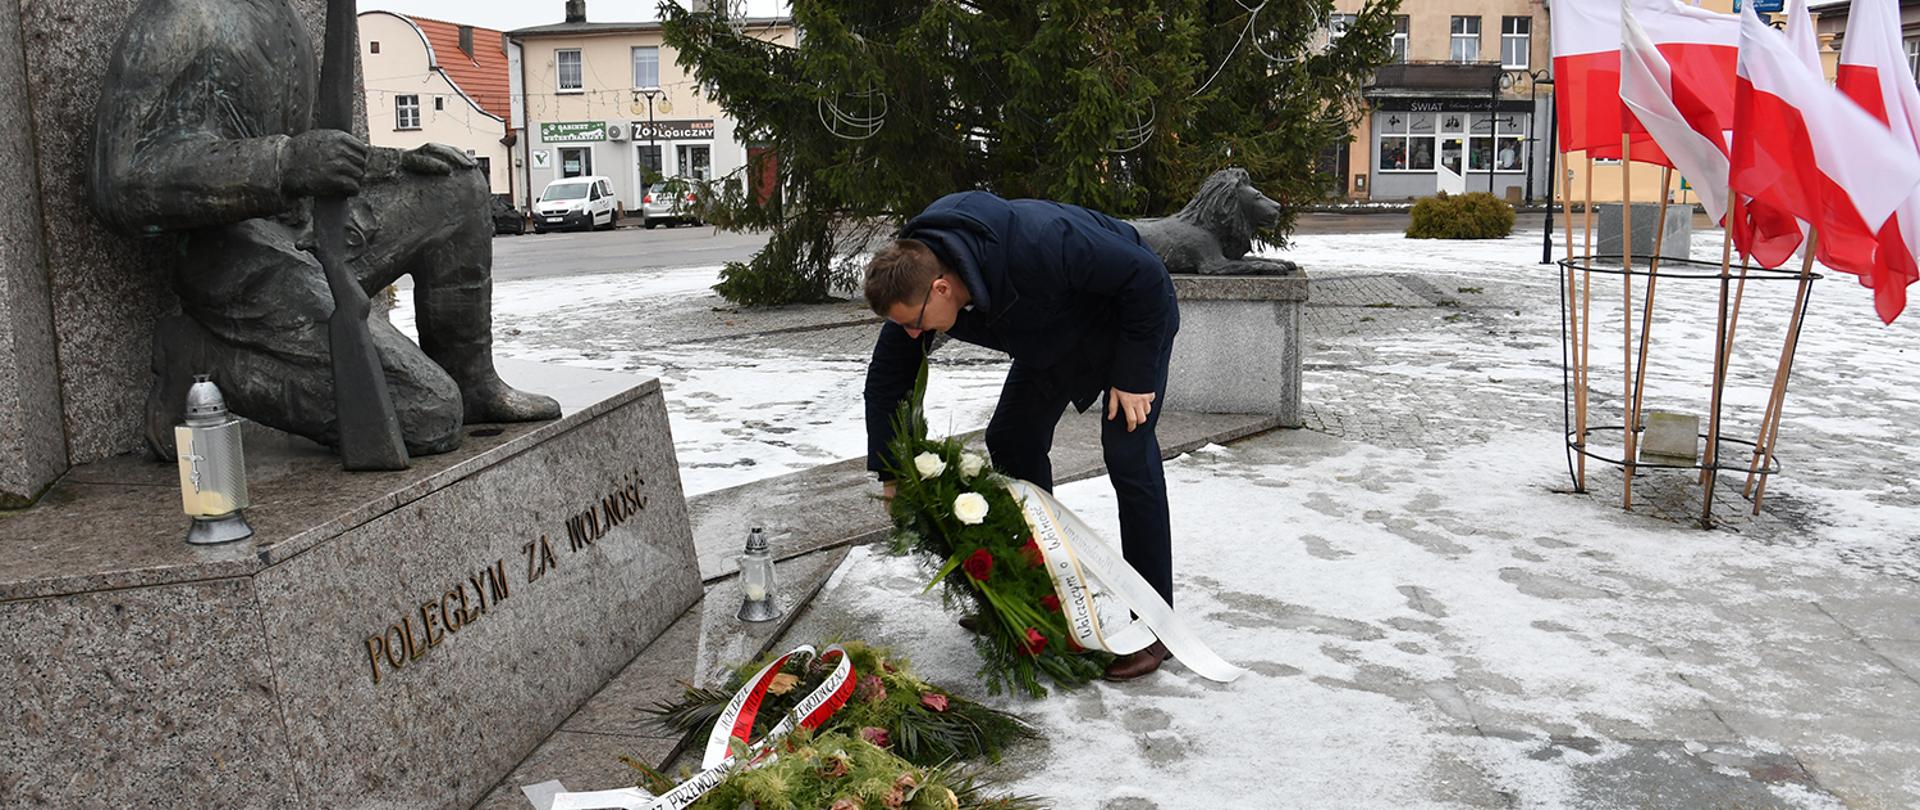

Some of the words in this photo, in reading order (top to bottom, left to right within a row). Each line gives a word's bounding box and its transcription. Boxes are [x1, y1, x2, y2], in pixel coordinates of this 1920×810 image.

[366, 558, 509, 685] POLEGŁYM
[520, 533, 557, 584] ZA
[565, 468, 648, 553] WOLNOŚĆ
[1059, 561, 1069, 570] o
